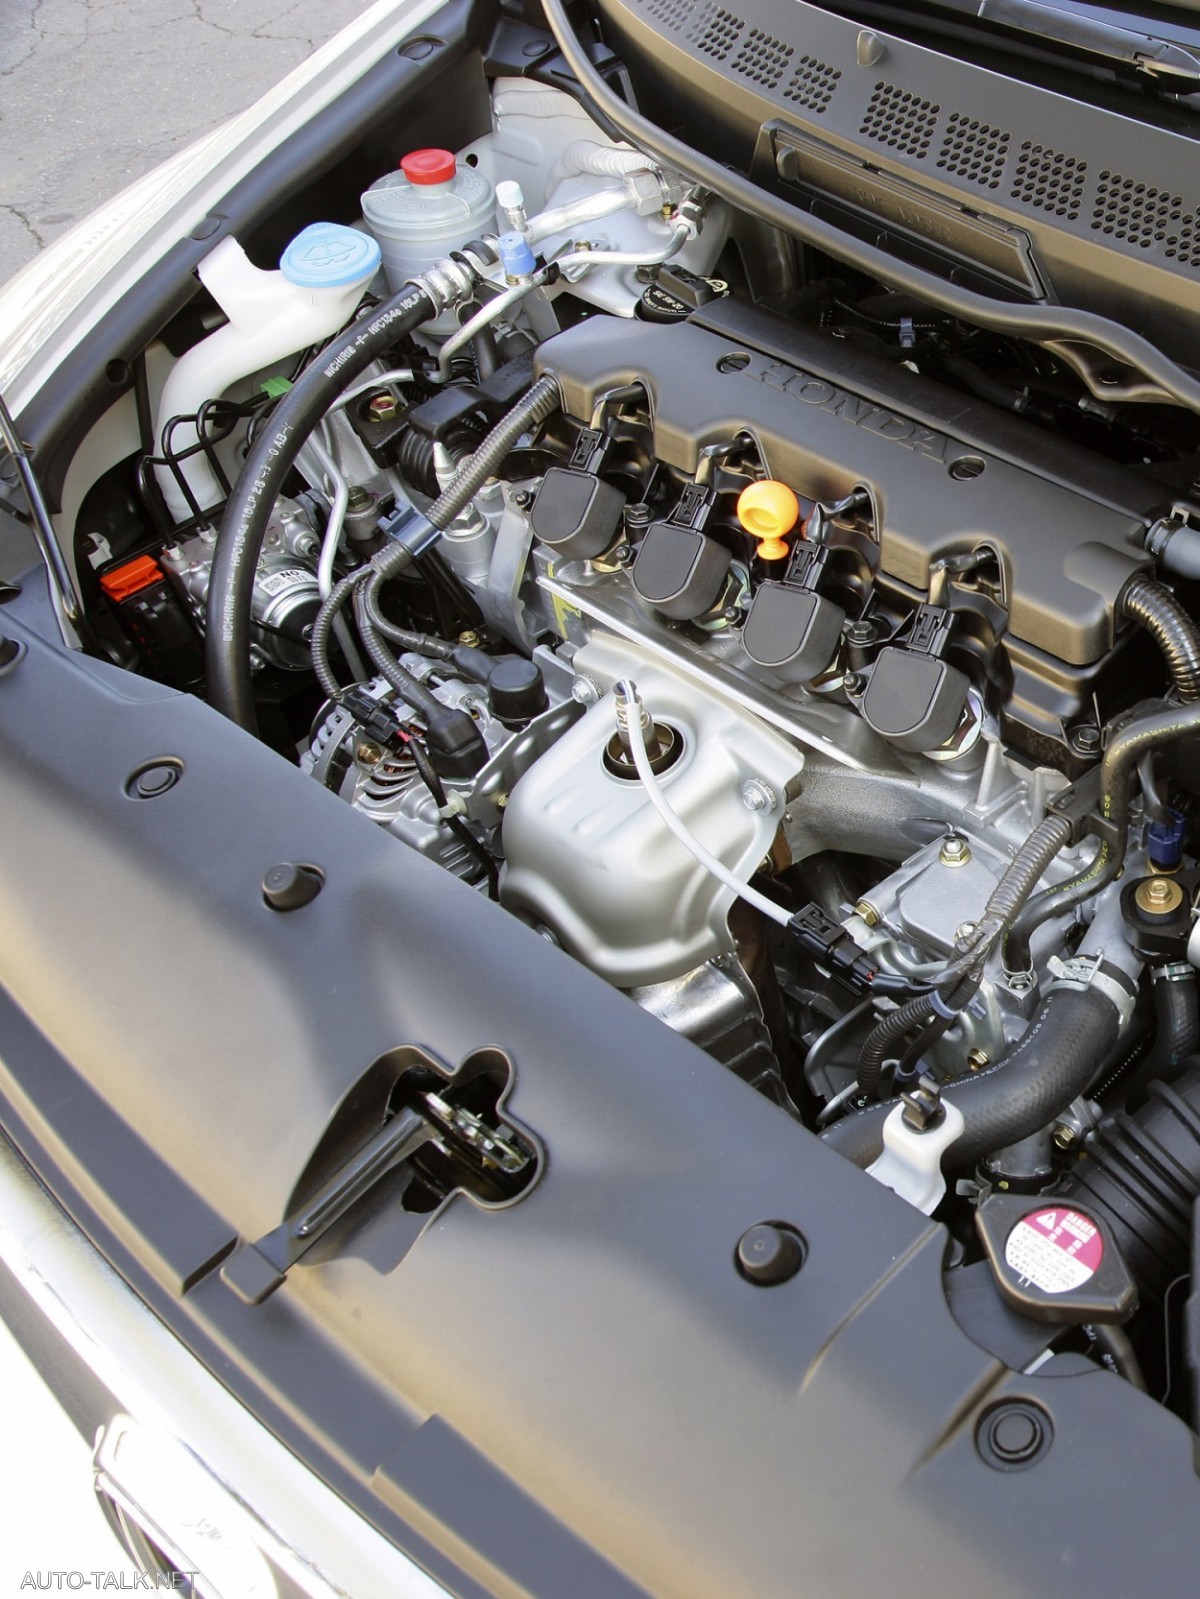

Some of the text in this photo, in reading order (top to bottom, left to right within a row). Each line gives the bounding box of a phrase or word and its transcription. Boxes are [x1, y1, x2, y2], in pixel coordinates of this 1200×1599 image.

[744, 361, 949, 466] HONDA
[1119, 722, 1187, 750] YAMASHITA
[1065, 1212, 1097, 1236] DANGER
